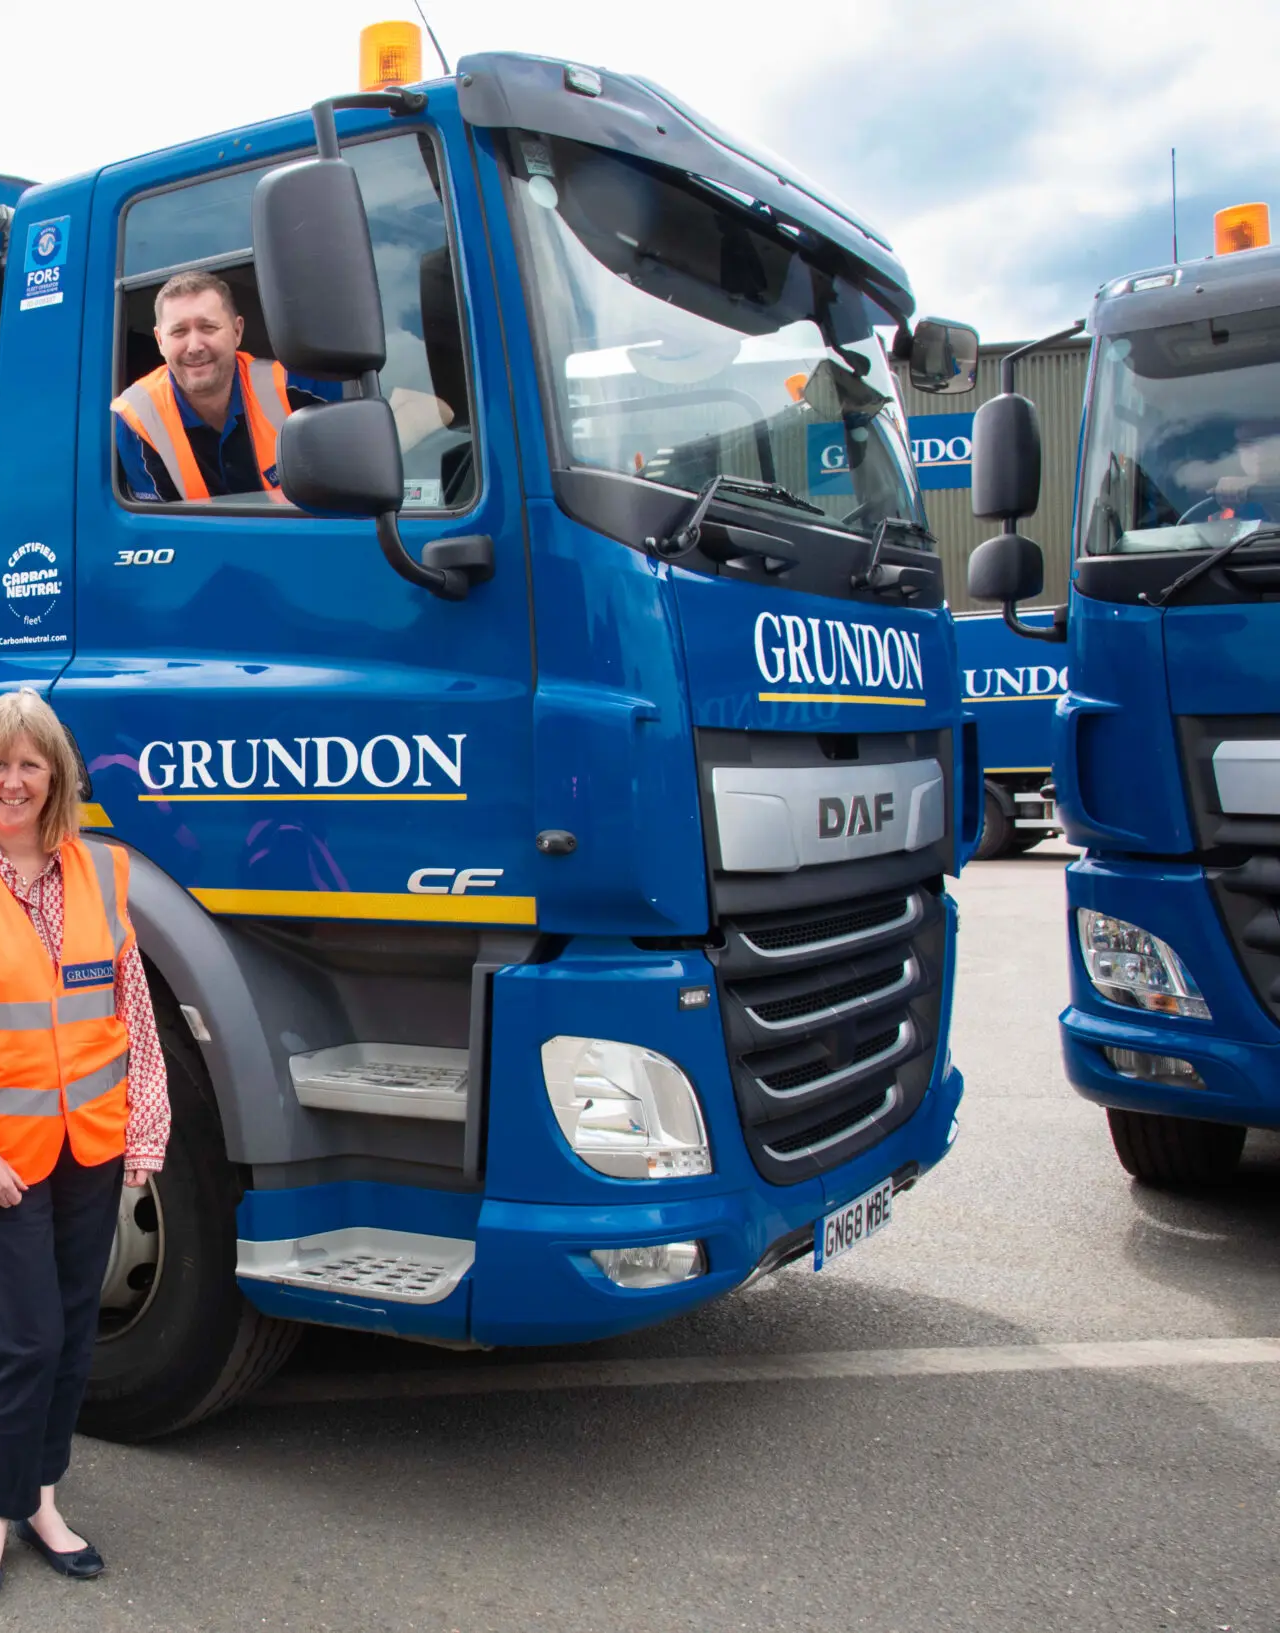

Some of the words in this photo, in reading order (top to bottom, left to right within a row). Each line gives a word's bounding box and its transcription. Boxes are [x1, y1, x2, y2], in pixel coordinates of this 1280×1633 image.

[27, 266, 60, 286] FORS
[7, 542, 56, 567] CERTIFIED
[114, 548, 175, 566] 300
[2, 568, 58, 587] CARBON
[23, 615, 42, 625] fleet
[754, 611, 924, 690] GRUNDON
[138, 733, 467, 789] GRUNDON
[818, 791, 894, 839] DAF
[407, 867, 504, 895] CF
[825, 1204, 863, 1257] GN68
